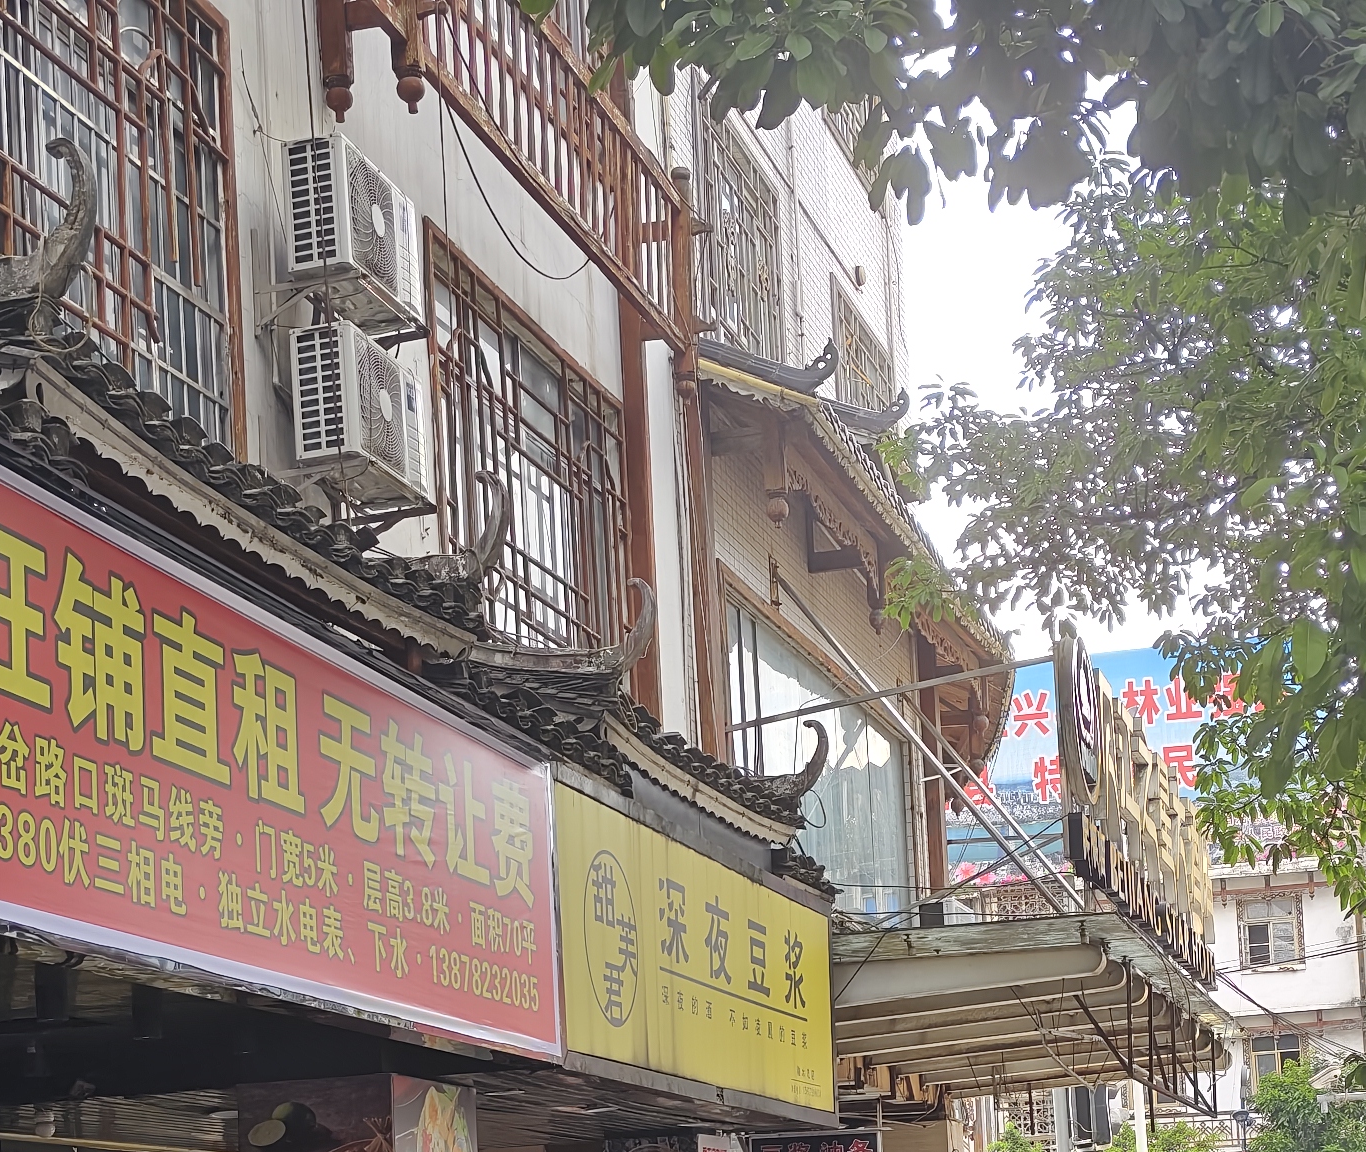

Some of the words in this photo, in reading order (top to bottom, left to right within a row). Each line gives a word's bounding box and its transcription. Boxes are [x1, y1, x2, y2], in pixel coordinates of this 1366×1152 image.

[318, 692, 536, 908] 无转让费
[658, 877, 806, 1010] 深夜豆浆
